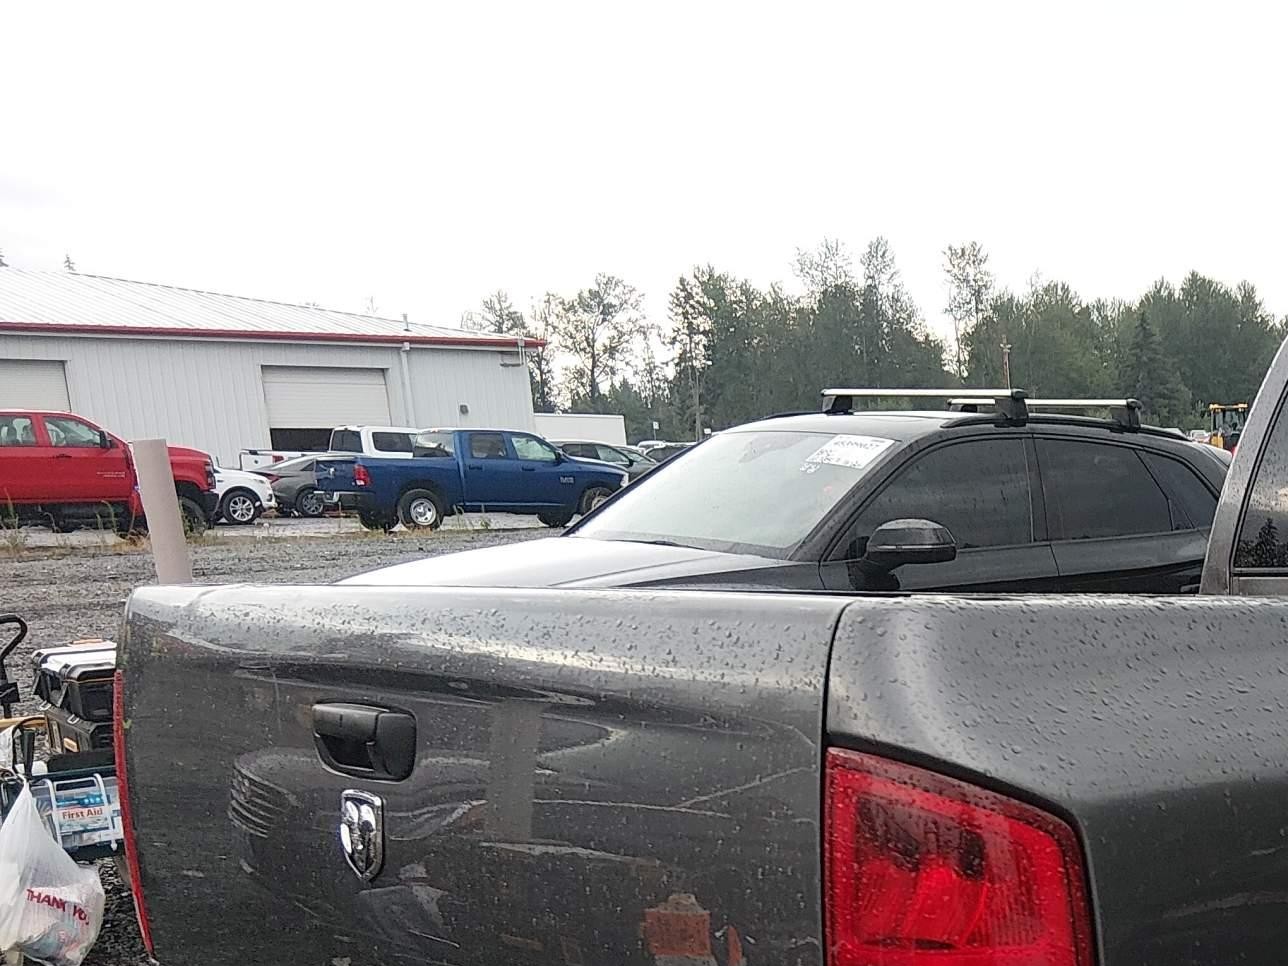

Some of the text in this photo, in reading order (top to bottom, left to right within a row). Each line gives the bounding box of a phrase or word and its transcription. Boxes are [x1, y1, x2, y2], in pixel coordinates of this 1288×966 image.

[62, 808, 103, 820] First Aid
[27, 889, 66, 912] THANK
